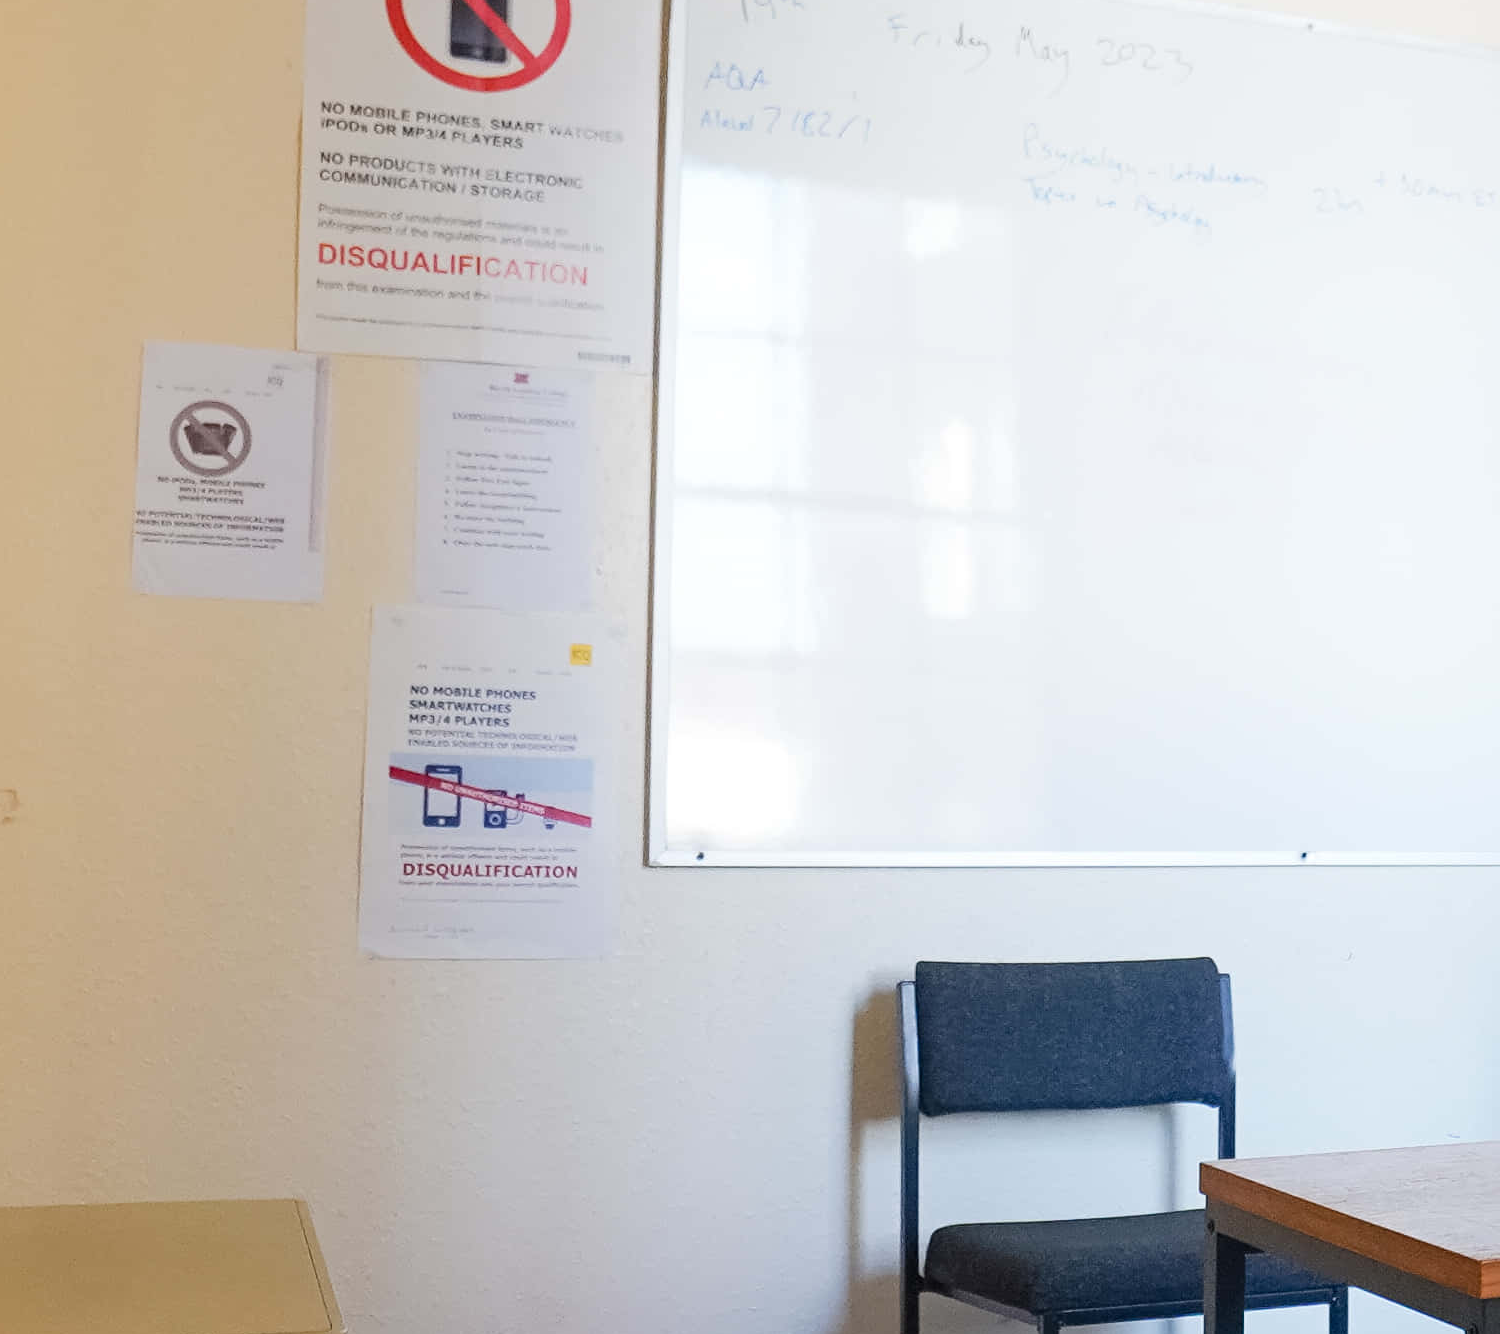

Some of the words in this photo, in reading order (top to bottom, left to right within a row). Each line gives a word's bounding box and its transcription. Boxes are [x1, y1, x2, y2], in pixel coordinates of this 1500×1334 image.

[1014, 23, 1071, 99] May
[321, 101, 345, 115] NO
[350, 104, 411, 122] MOBILE
[490, 118, 544, 134] SMART
[373, 122, 396, 136] OR
[402, 126, 447, 140] MP3/4
[451, 131, 524, 149] PLAYERS
[319, 152, 344, 165] NO
[349, 154, 436, 175] PRODUCTS
[442, 165, 480, 179] WITH
[485, 169, 583, 189] ELECTRONIC
[319, 169, 457, 194] COMMUNICATION
[471, 184, 545, 202] STORAGE
[318, 242, 588, 286] DISQUALIFICATION
[409, 700, 512, 714] SMARTWATCHES
[410, 685, 428, 695] NO
[432, 686, 481, 698] MOBILE
[486, 689, 536, 700] PHONES
[454, 716, 510, 727] PLAYERS
[403, 863, 578, 879] DISQUALIFICATION
